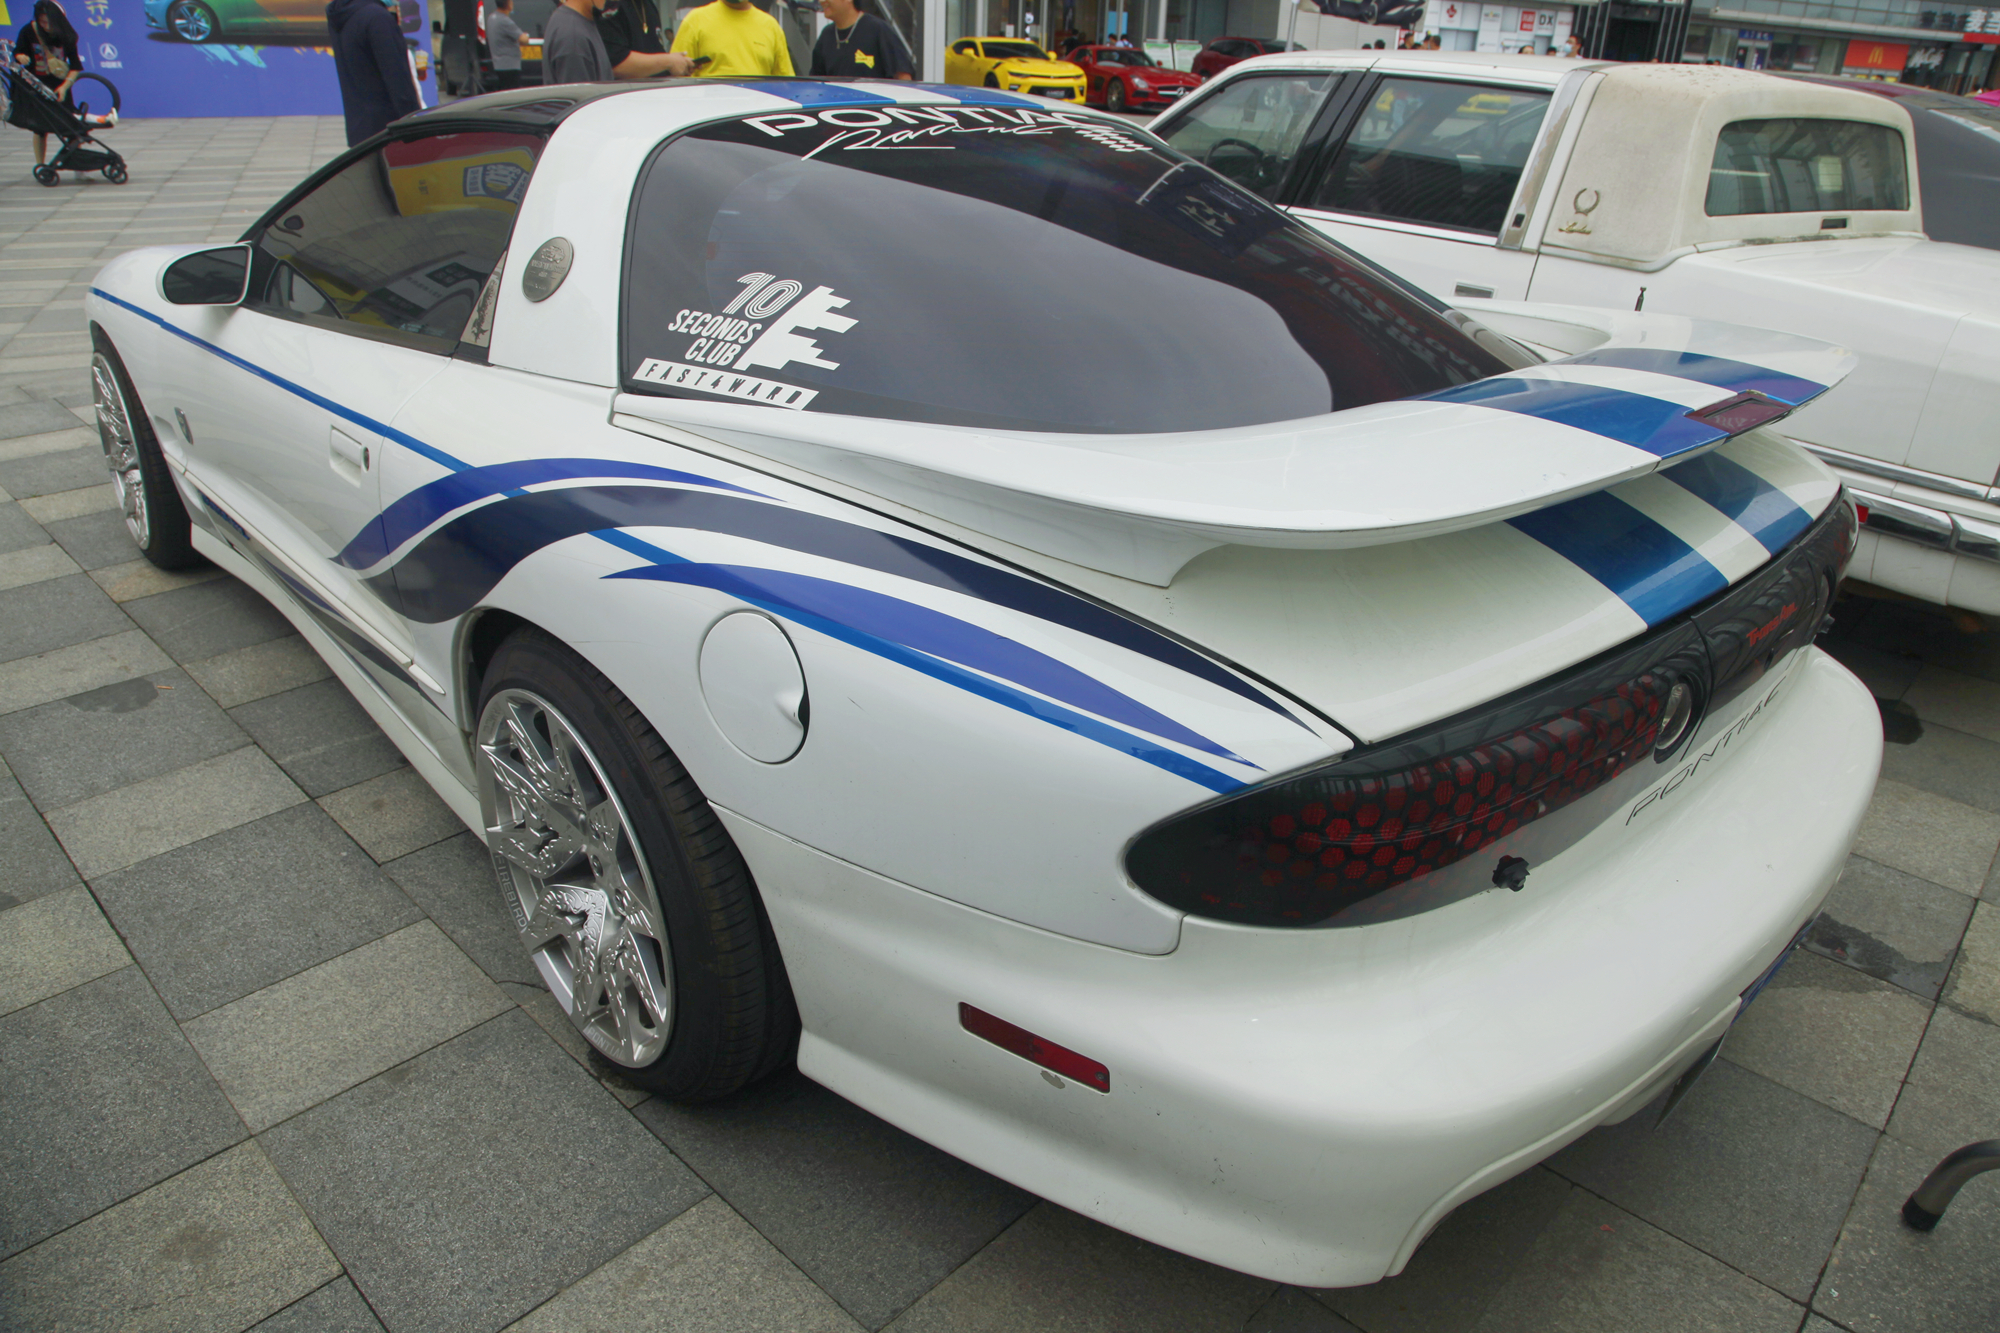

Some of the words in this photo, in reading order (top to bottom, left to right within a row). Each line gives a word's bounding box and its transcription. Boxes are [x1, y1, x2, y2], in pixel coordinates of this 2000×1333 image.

[1539, 13, 1554, 26] DX
[743, 107, 1114, 137] PONTIAC
[722, 272, 803, 320] 10
[668, 309, 762, 344] SECONDS
[685, 337, 741, 366] CLUB
[645, 363, 803, 405] FAST4WARD
[1625, 675, 1787, 826] PONTIAC
[495, 854, 527, 928] FIREBIRD
